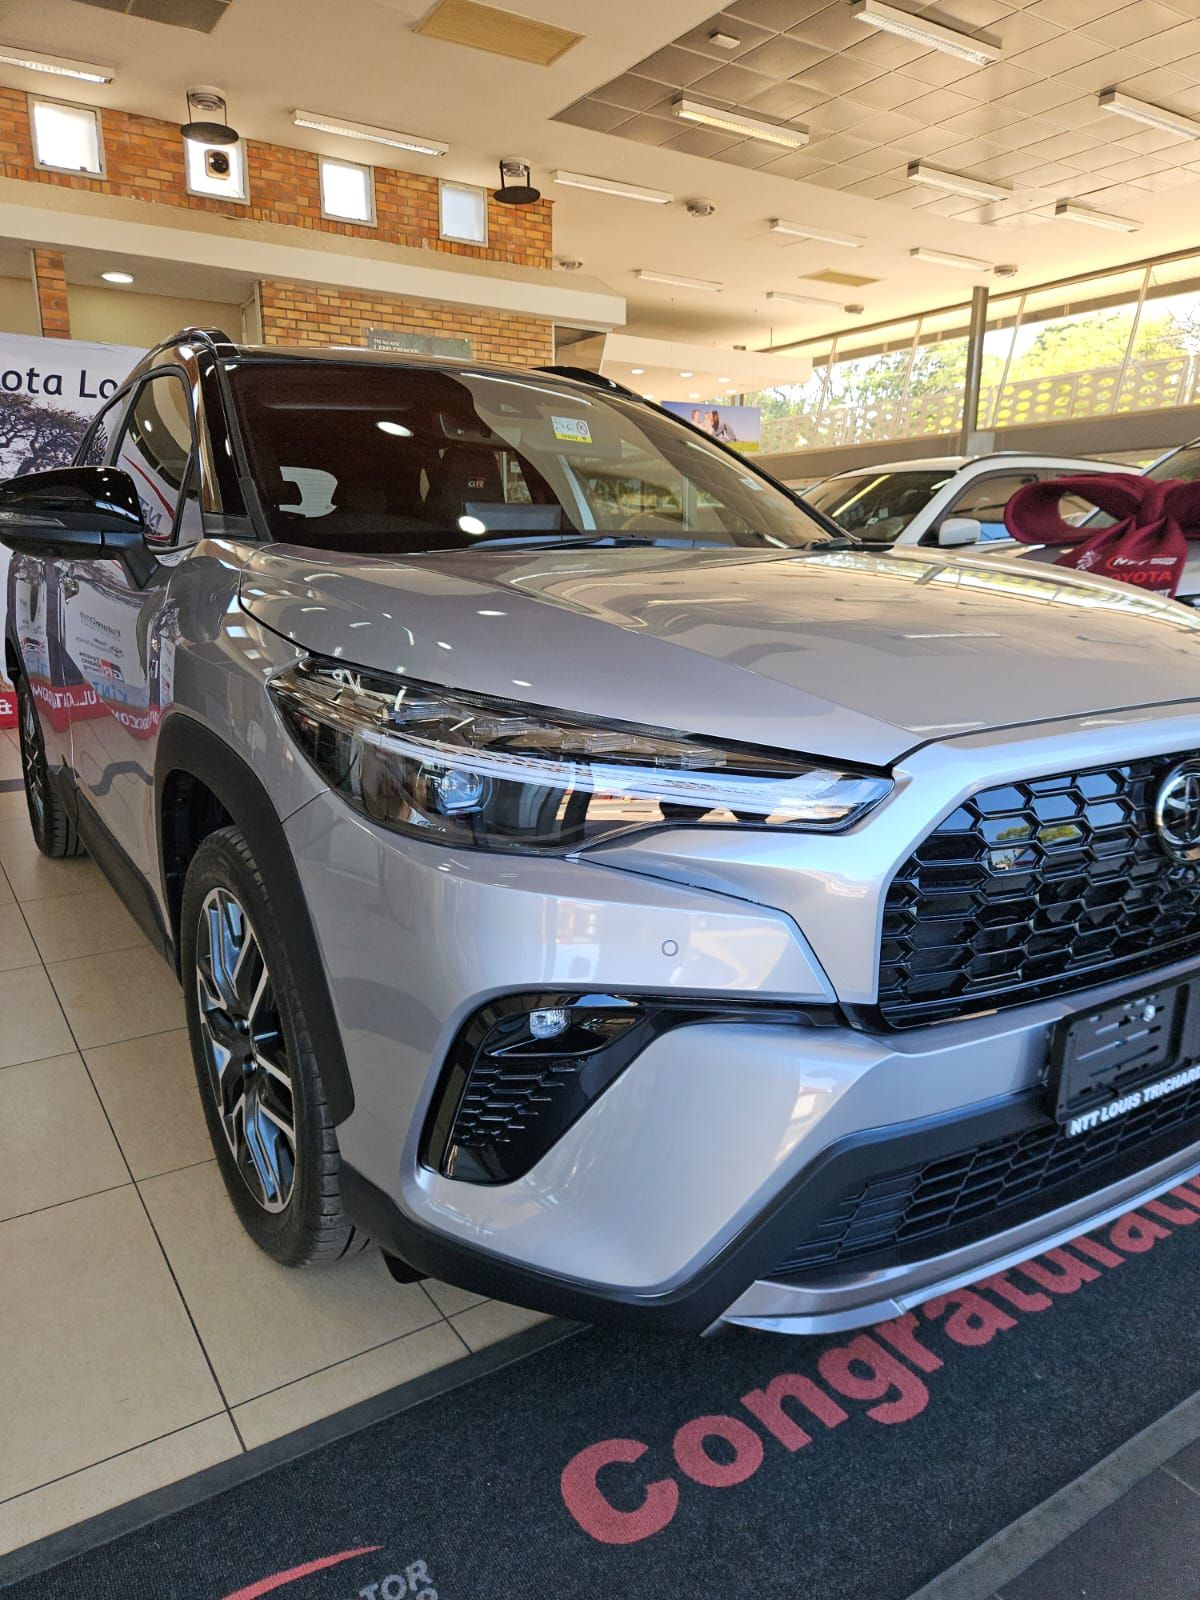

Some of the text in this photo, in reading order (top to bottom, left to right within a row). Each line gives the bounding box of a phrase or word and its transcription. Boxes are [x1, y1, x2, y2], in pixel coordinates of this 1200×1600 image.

[1109, 570, 1173, 583] OYOTA
[1070, 1111, 1100, 1135] NTT
[1101, 1093, 1141, 1121] LOUIS
